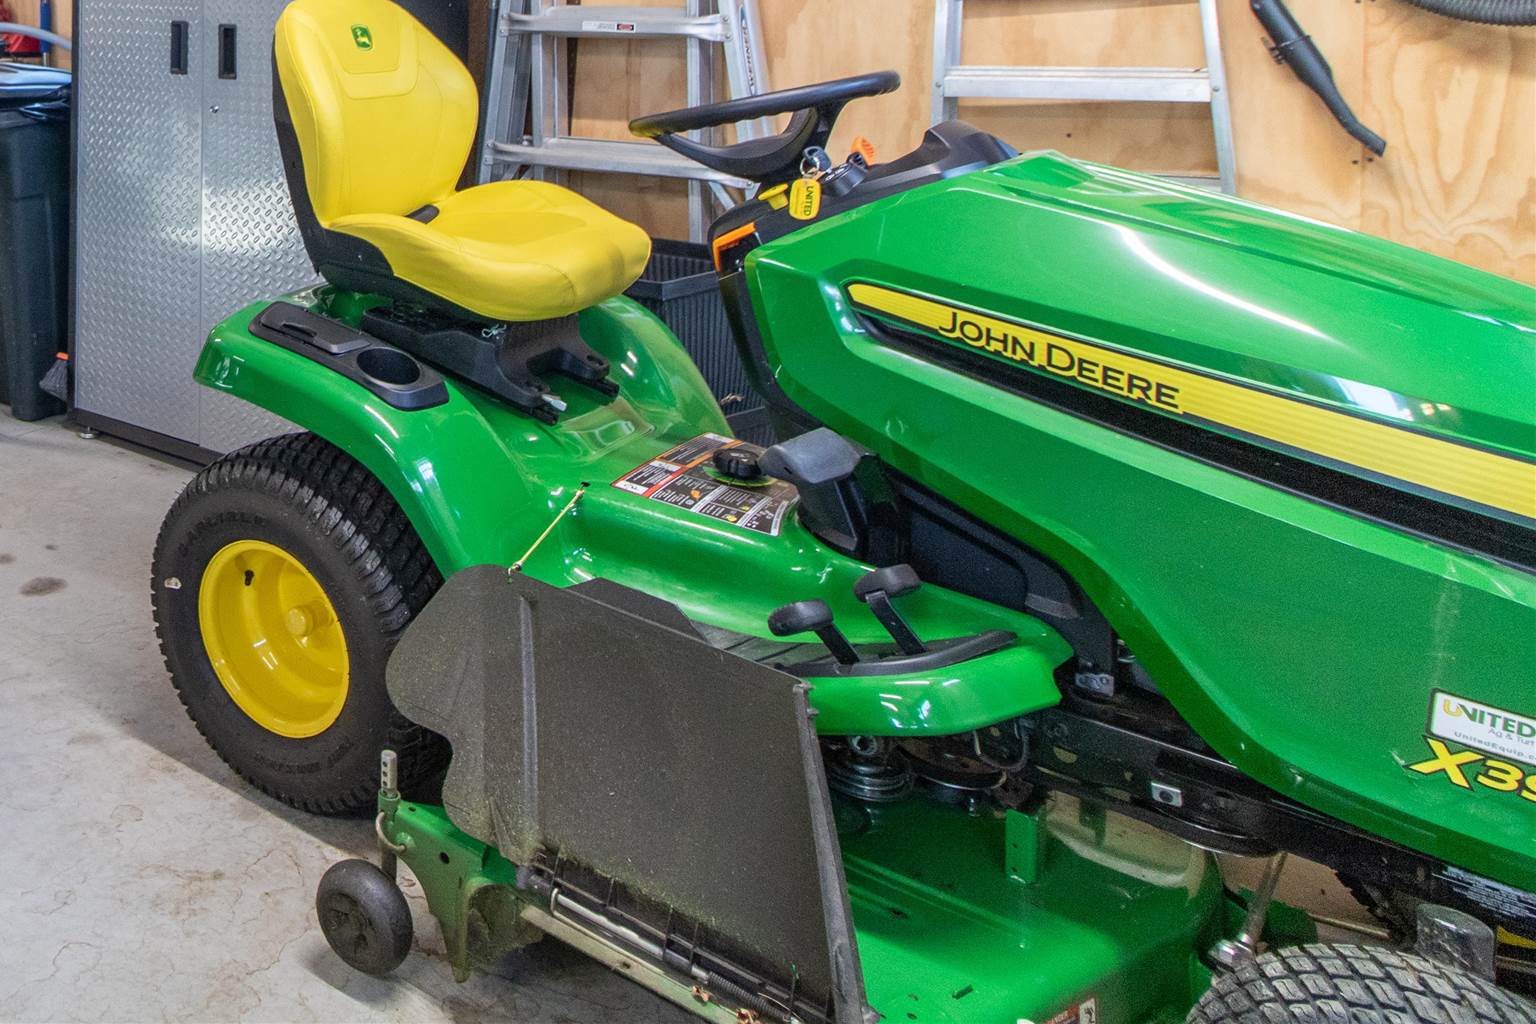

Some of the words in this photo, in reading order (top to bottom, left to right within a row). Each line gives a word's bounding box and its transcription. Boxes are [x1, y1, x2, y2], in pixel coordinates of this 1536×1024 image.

[803, 184, 817, 217] UNITED
[939, 311, 1037, 363] JOHN
[1046, 341, 1181, 410] DEERE
[1443, 698, 1536, 738] UNITED
[1453, 731, 1536, 761] UnitedEquip.c
